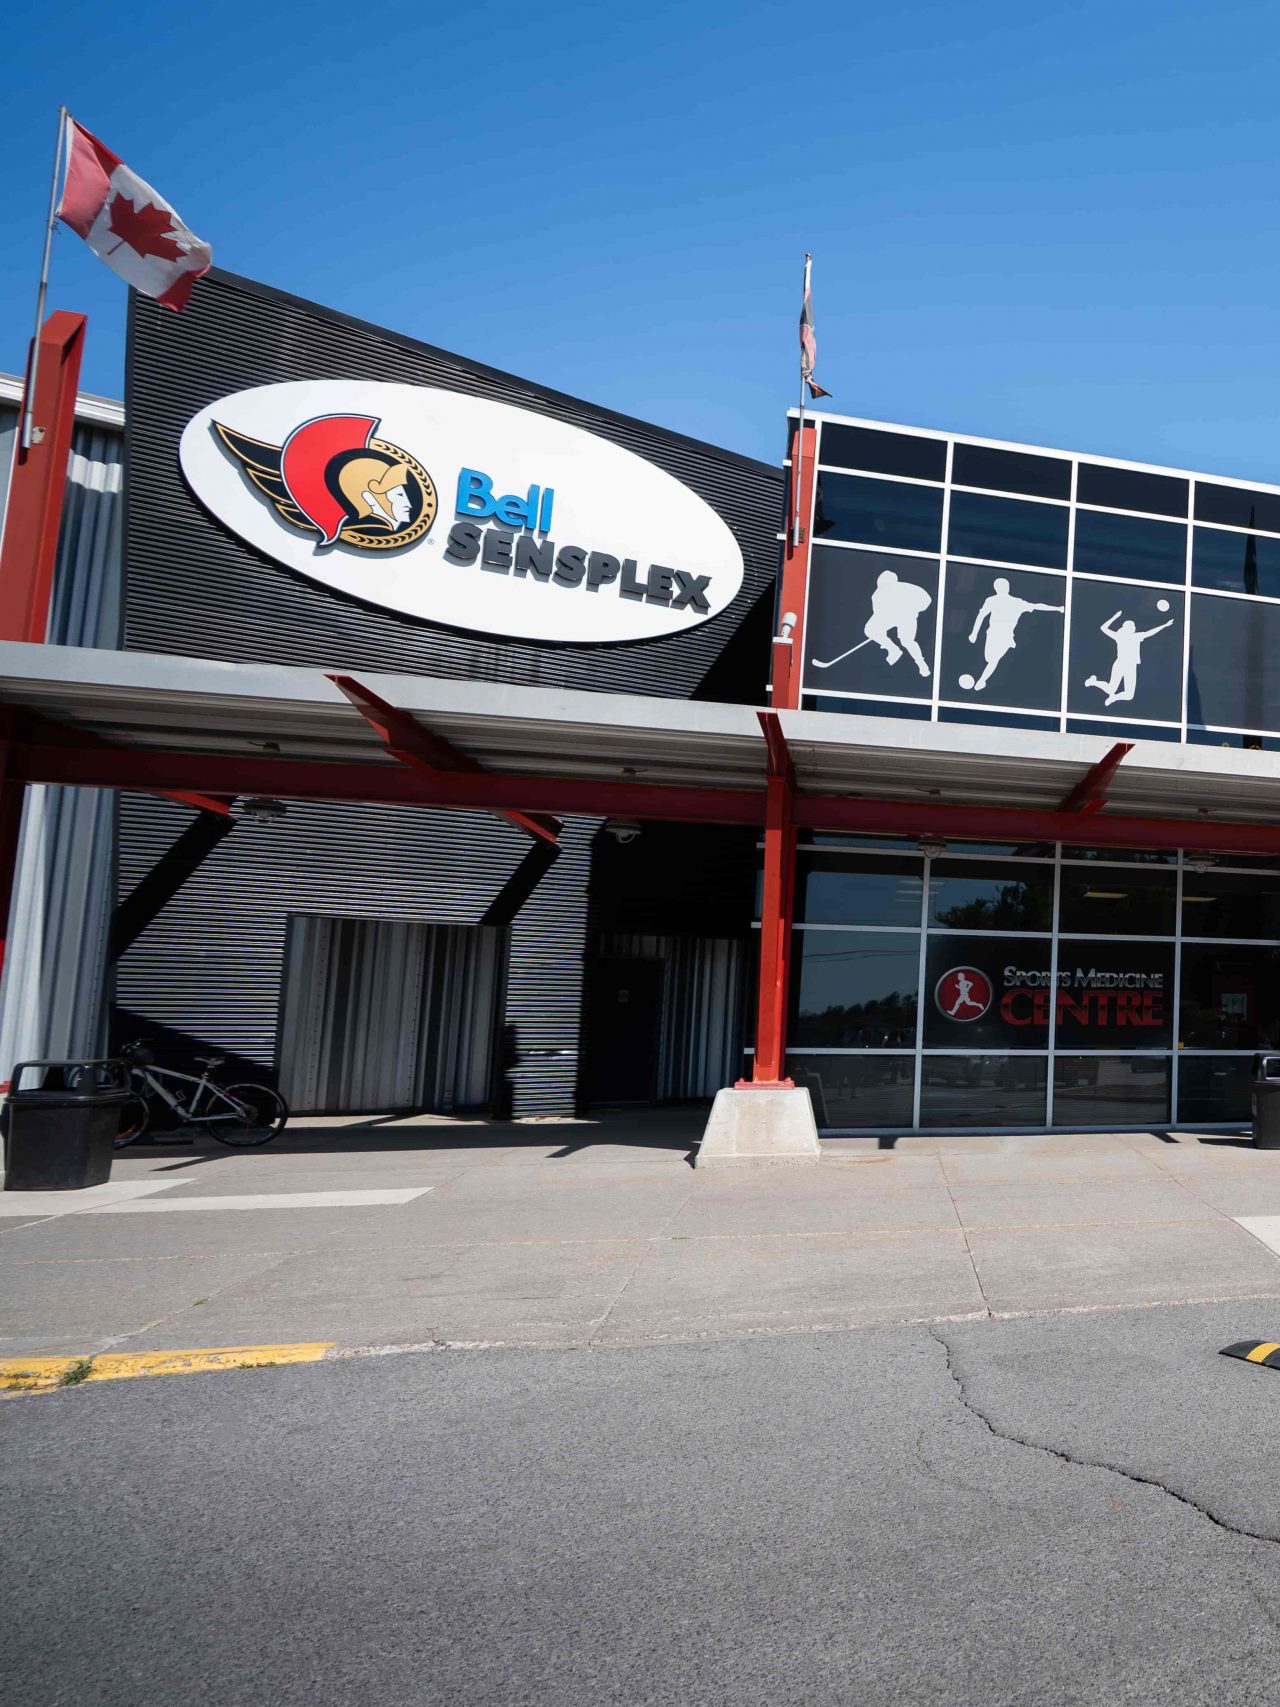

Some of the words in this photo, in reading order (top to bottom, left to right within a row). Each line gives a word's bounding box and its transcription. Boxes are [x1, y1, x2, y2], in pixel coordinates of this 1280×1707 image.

[456, 467, 554, 532] Bell
[445, 522, 712, 609] SENSPLEX
[1074, 967, 1164, 989] MEDICINE
[1000, 987, 1164, 1026] CENTRE
